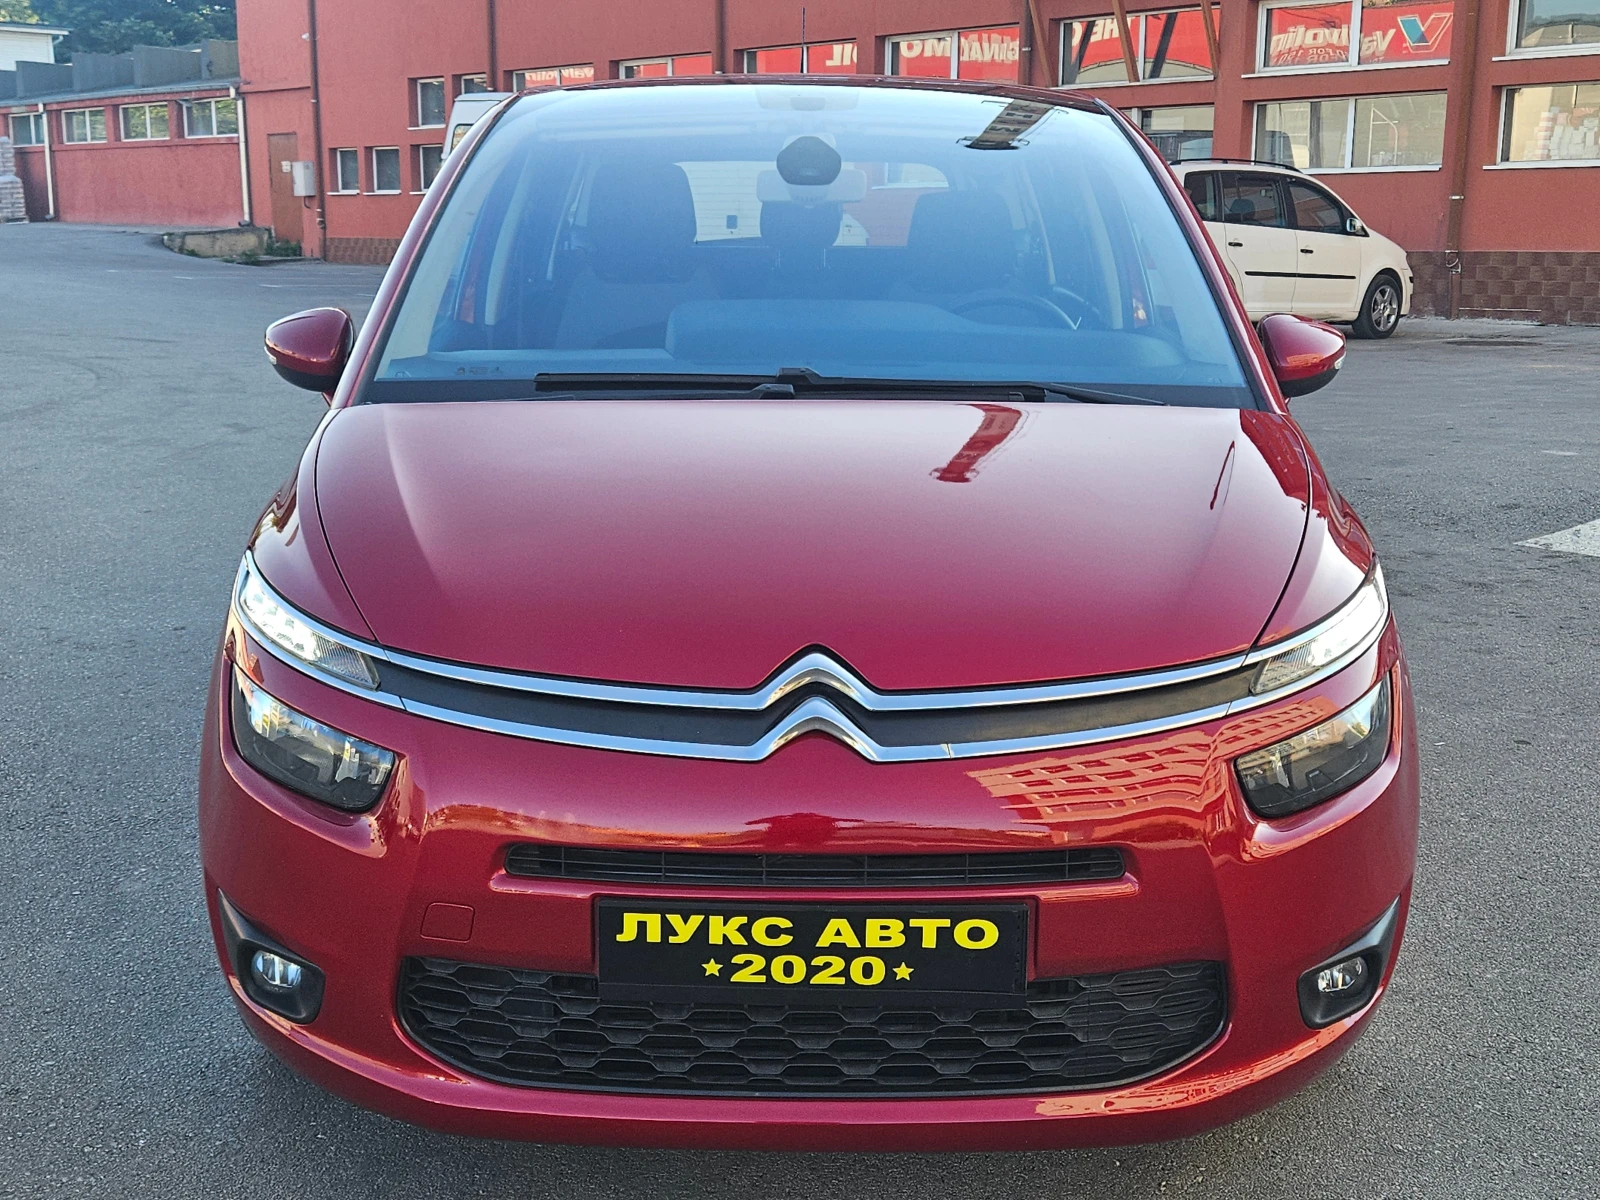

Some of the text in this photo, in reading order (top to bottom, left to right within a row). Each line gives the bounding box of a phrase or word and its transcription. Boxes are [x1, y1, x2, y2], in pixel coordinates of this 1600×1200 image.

[616, 912, 1000, 950] ЛУКС АВТО
[730, 953, 886, 985] 2020
